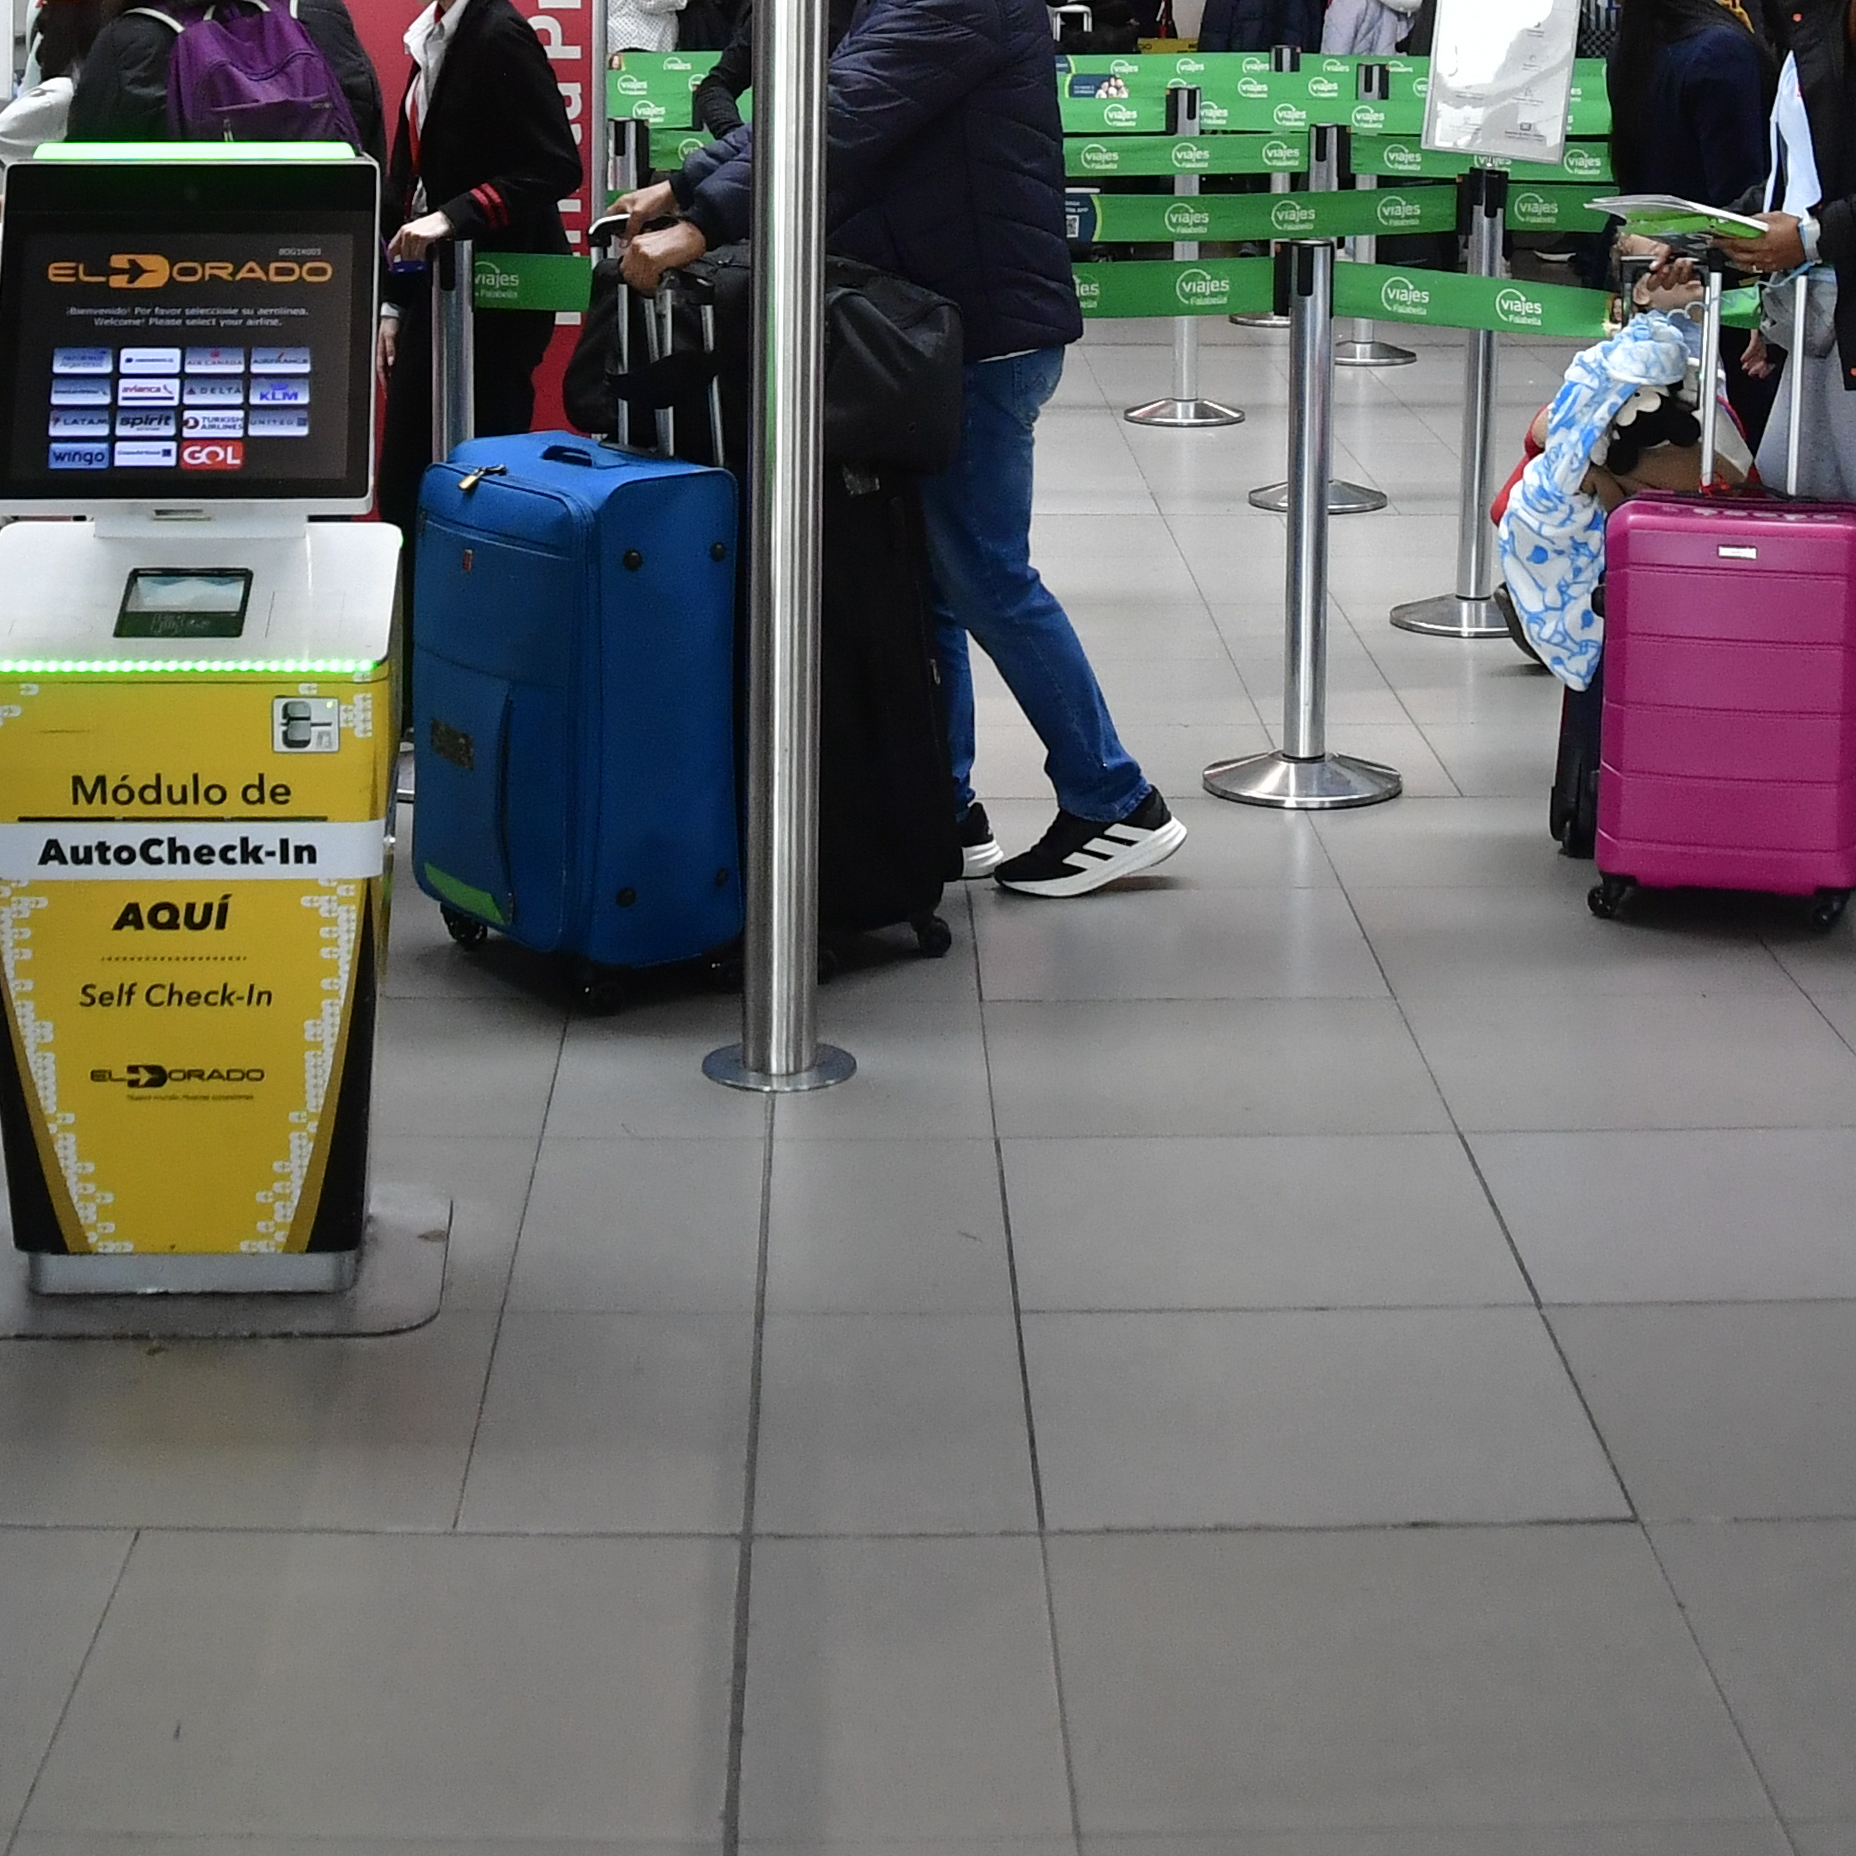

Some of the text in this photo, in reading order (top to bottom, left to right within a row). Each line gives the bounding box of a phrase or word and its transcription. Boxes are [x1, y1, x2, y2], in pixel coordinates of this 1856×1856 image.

[1085, 150, 1119, 163] viajes
[1177, 149, 1210, 163] viajes
[1266, 147, 1299, 161] viajes
[1388, 151, 1422, 164] viajes
[1568, 157, 1601, 168] viajes
[1276, 208, 1315, 223] viajes
[1381, 203, 1421, 218] viajes
[1519, 203, 1558, 216] viajes
[1169, 211, 1209, 226] viajes
[48, 262, 106, 282] EL
[475, 273, 519, 289] viajes
[1181, 278, 1229, 296] viajes
[1387, 288, 1430, 305] viajes
[134, 307, 151, 315] Por
[155, 307, 181, 315] favor
[1501, 300, 1542, 317] viajes
[149, 317, 182, 326] Please
[186, 317, 216, 326] select
[219, 319, 243, 328] your
[1508, 316, 1542, 326] Falabella
[122, 384, 162, 393] avianca
[259, 392, 298, 401] KLM
[119, 414, 172, 428] spirit
[52, 450, 106, 465] wingo
[183, 445, 241, 464] GOL
[70, 774, 292, 808] Módulo de
[37, 836, 318, 867] AutoCheck-In
[113, 894, 233, 932] AQUÍ
[79, 983, 273, 1009] Self Check-In
